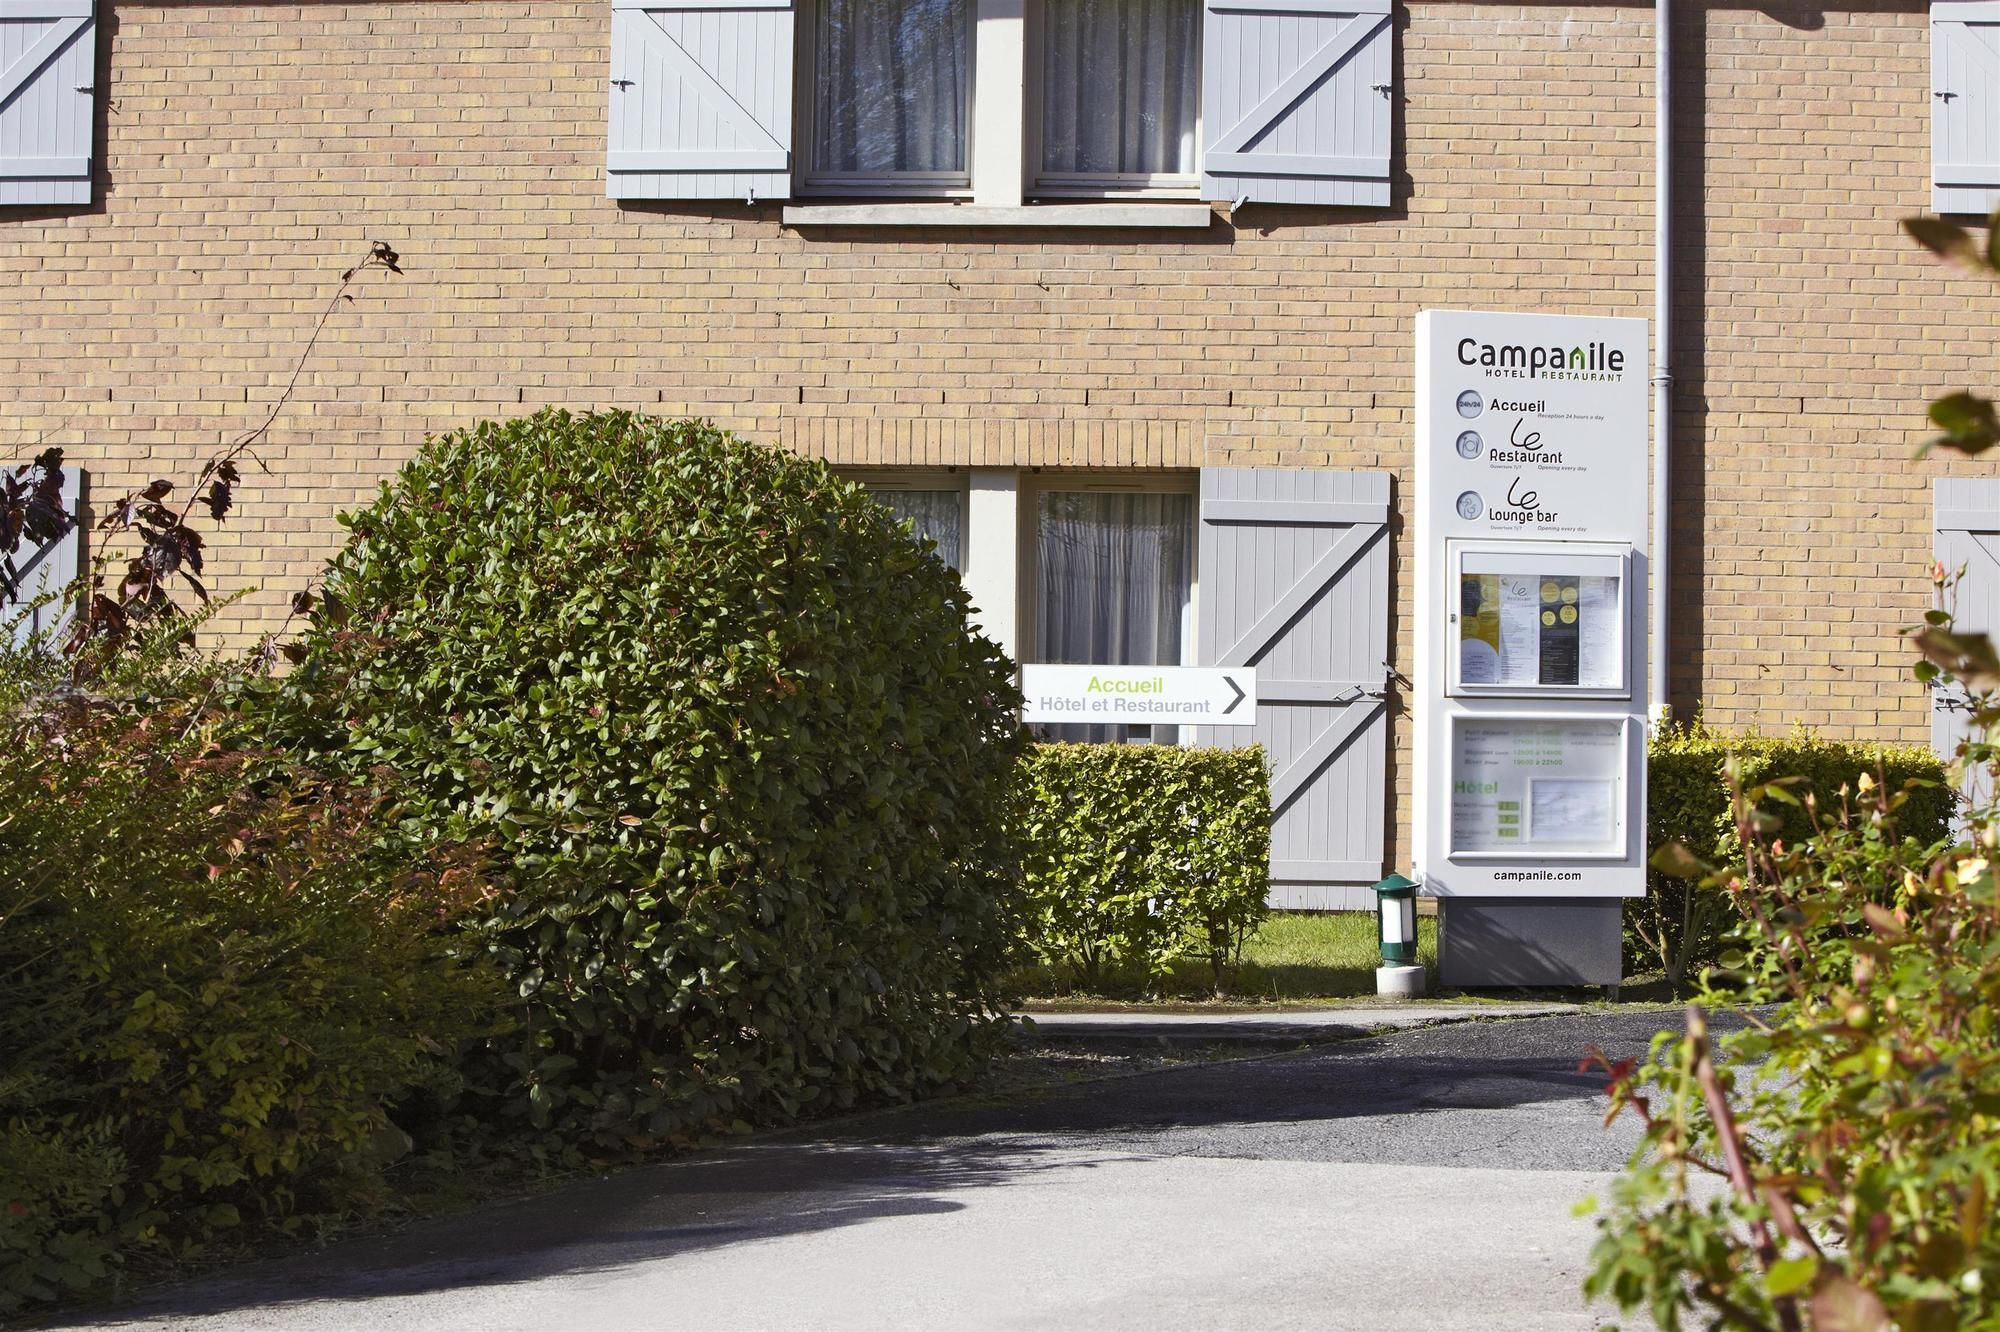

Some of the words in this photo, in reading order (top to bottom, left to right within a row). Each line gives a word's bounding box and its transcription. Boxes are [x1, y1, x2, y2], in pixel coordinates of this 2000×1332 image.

[1457, 337, 1625, 379] Campanile
[1485, 368, 1526, 379] HOTEL
[1541, 371, 1623, 383] RESTAURANT
[1490, 398, 1545, 413] Accueil
[1594, 413, 1605, 422] day
[1489, 448, 1563, 464] Restaurant
[1537, 464, 1560, 472] Opening
[1576, 465, 1587, 473] day
[1489, 507, 1534, 525] Lounge
[1536, 509, 1559, 523] bar
[1537, 525, 1560, 533] Opening
[1576, 526, 1587, 534] day
[1087, 675, 1163, 694] Accueil
[1040, 696, 1086, 712] Hôtel
[1091, 700, 1109, 713] et
[1114, 697, 1211, 713] Restaurant
[1493, 870, 1582, 882] campanile.com
